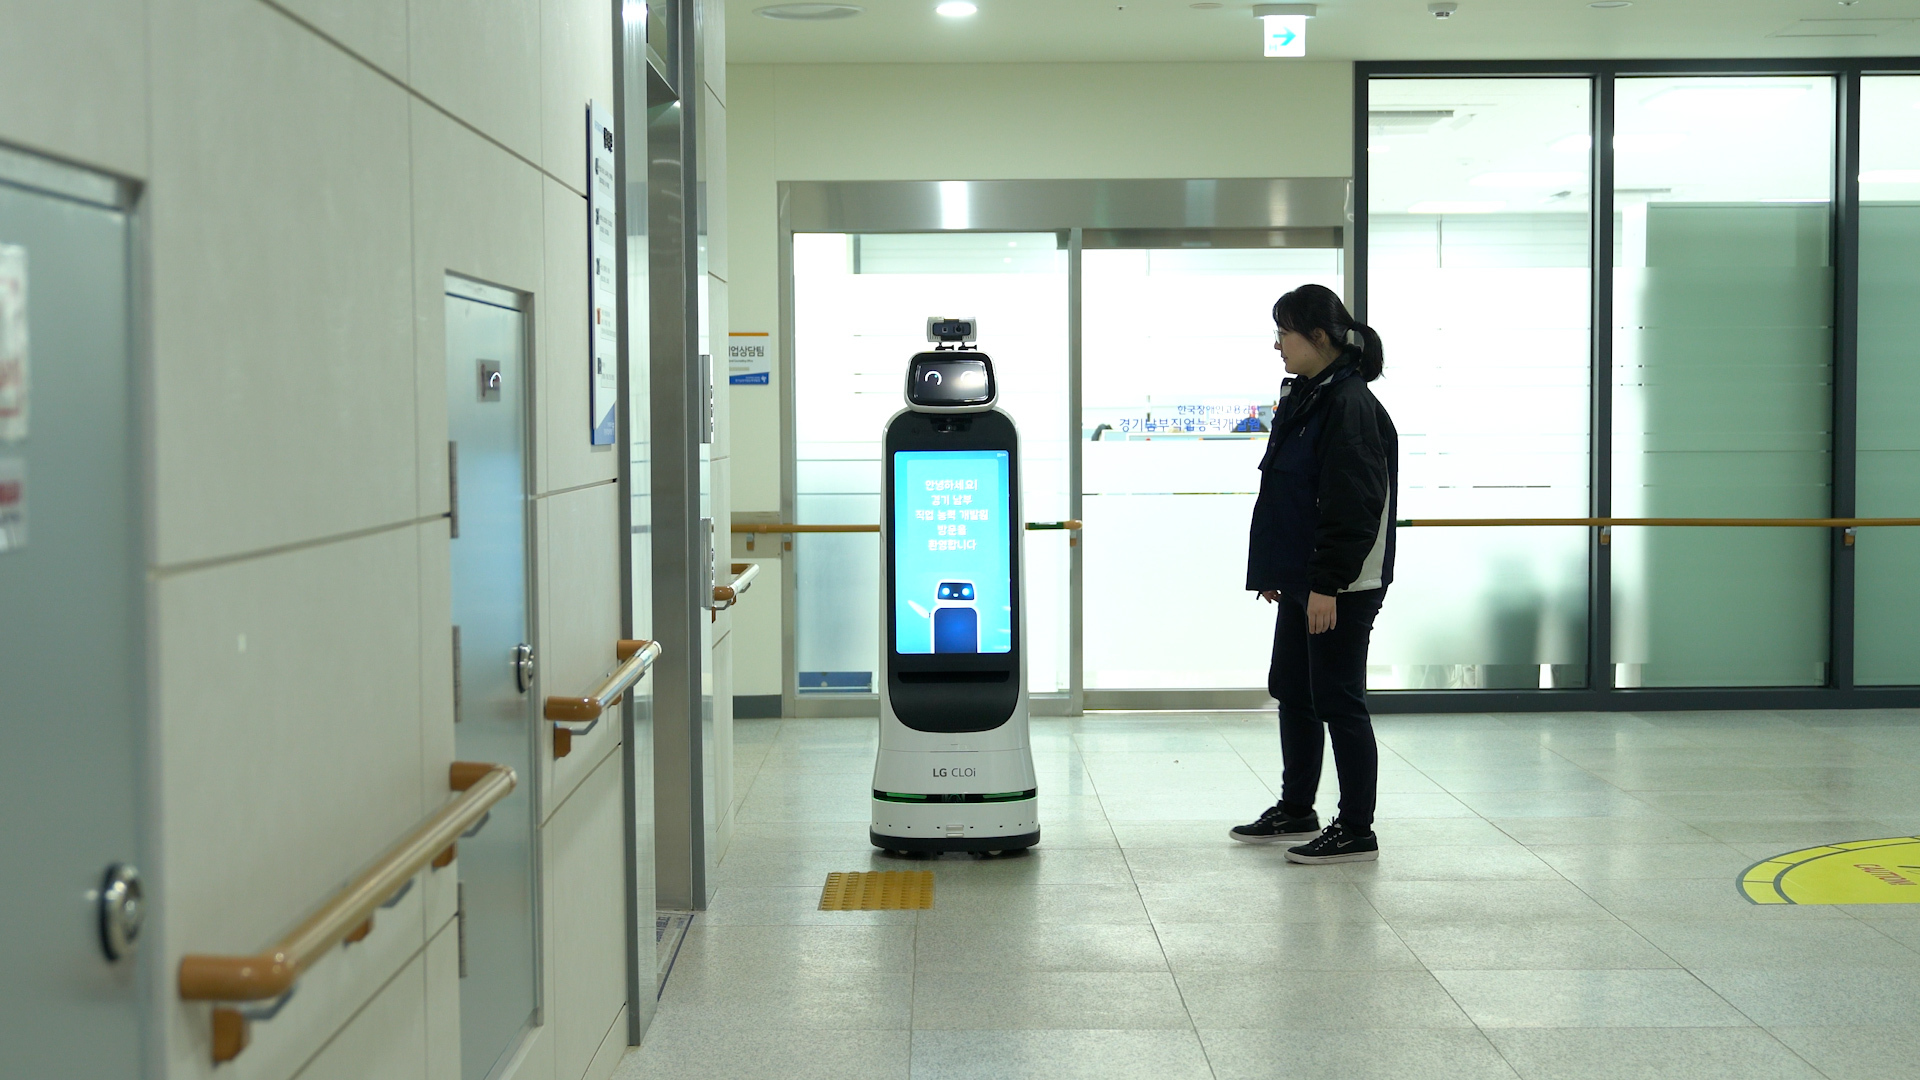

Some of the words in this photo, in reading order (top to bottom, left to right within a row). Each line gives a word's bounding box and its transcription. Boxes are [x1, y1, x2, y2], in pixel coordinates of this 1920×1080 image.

[729, 345, 764, 357] 업상담팀
[1177, 405, 1260, 415] 한국장애인고용공단
[1119, 417, 1260, 433] 경기남부직업능력개발원
[931, 494, 950, 506] 경기
[952, 494, 973, 506] 남부
[915, 509, 934, 521] 직업
[937, 509, 956, 521] 능력
[959, 509, 989, 521] 개발원
[937, 524, 967, 536] 방문을
[928, 539, 977, 551] 환영합니다
[932, 767, 948, 778] LG
[951, 767, 976, 778] CLOi
